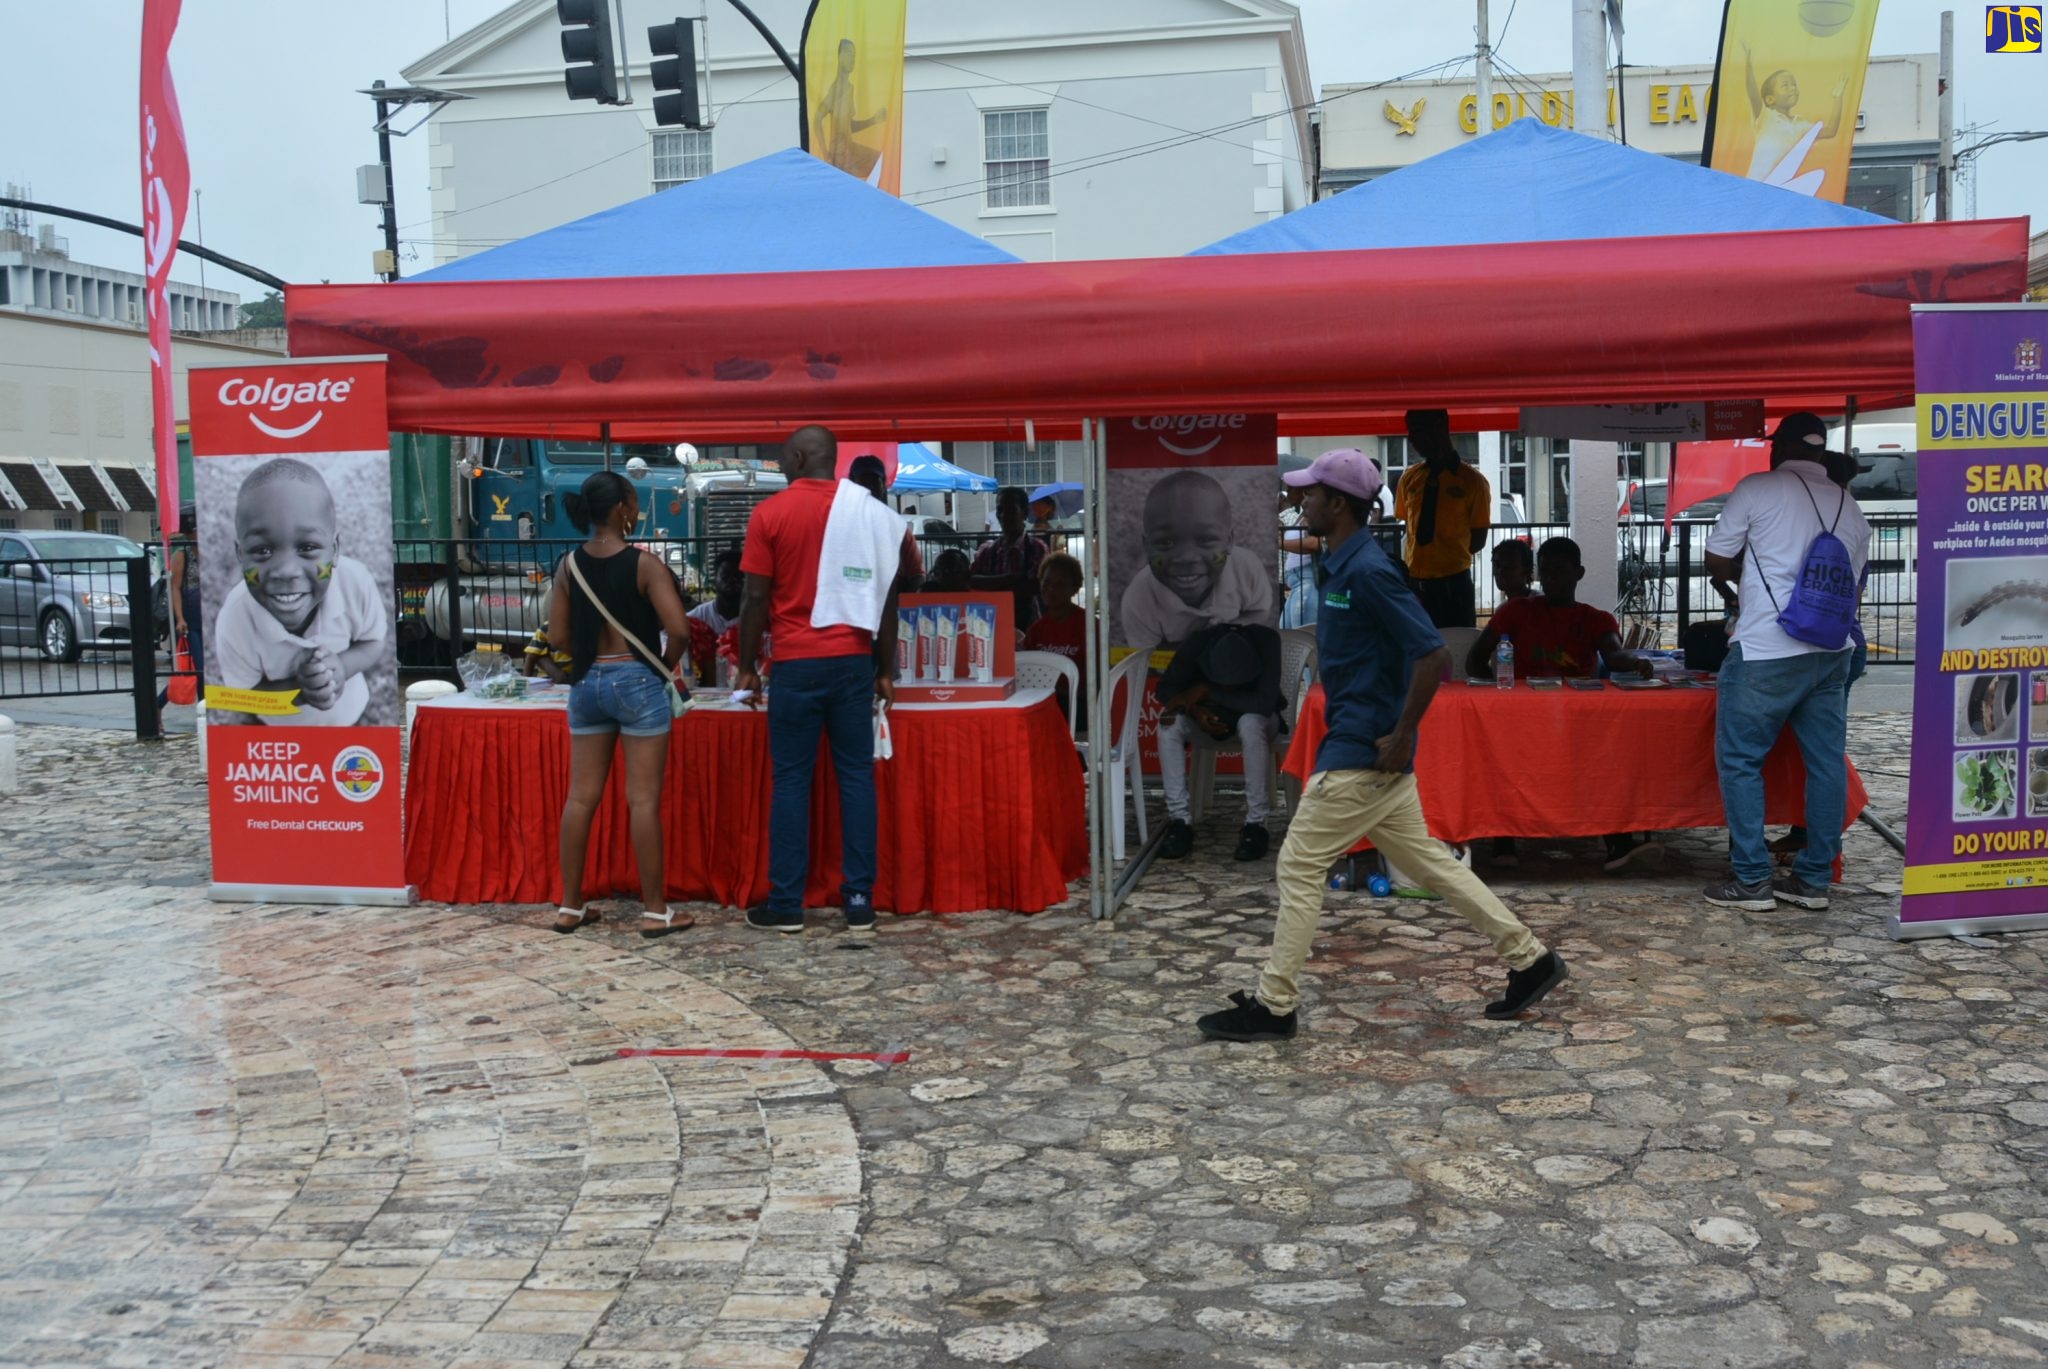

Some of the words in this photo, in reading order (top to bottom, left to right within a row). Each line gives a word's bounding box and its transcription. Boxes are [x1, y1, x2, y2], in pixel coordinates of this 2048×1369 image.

[1994, 373, 2024, 382] Ministry
[2026, 373, 2035, 381] of
[218, 377, 351, 412] Colgate
[1713, 410, 1743, 420] Stops
[1931, 401, 2048, 440] DENGUE
[1714, 423, 1736, 431] You.
[1965, 463, 2048, 494] SEAR
[1966, 497, 2007, 513] ONCE
[2010, 495, 2037, 511] PER
[1983, 520, 1990, 531] &
[1992, 518, 2024, 531] outside
[2025, 520, 2045, 533] your
[1933, 537, 1973, 551] workplace
[1974, 536, 1988, 548] for
[1989, 535, 2015, 547] Aedes
[1803, 559, 1855, 588] HIGH
[1801, 578, 1855, 600] GRADES
[1940, 649, 1974, 671] AND
[247, 742, 300, 760] KEEP
[225, 763, 325, 783] JAMAICA
[234, 785, 319, 804] SMILING
[247, 819, 269, 829] Free
[271, 820, 305, 830] Dental
[306, 820, 364, 831] CHECKUPS
[1953, 833, 1980, 855] DO
[1982, 830, 2031, 853] YOUR
